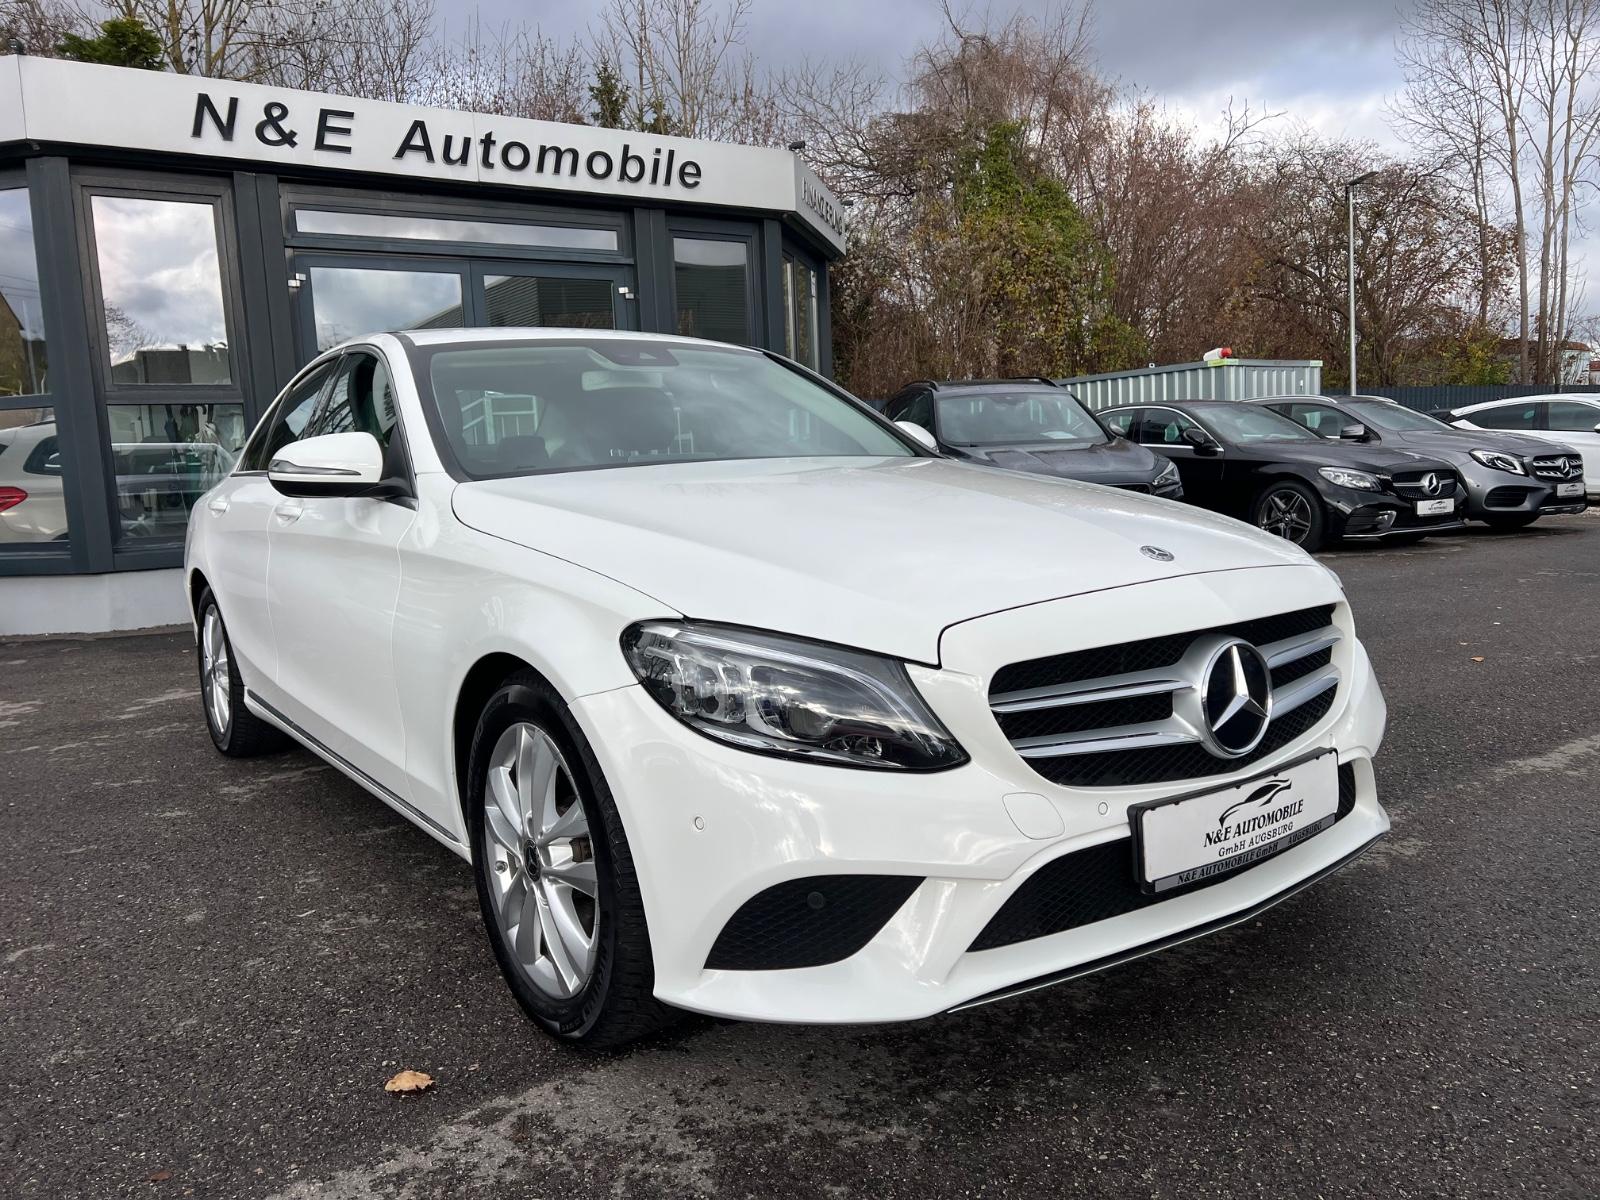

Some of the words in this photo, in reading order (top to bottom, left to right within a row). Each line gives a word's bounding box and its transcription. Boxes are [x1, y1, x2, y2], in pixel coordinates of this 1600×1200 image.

[392, 119, 702, 189] Automobile
[1203, 826, 1231, 848] N&E
[1233, 799, 1304, 839] AUTOMOBILE
[1218, 840, 1246, 857] GmbH
[1248, 821, 1294, 847] AUGSBURG
[1177, 867, 1198, 884] N&E
[1199, 851, 1255, 878] AUTOMOBILE
[1256, 842, 1279, 859] GmbH
[1288, 821, 1322, 845] AUGSBURG
